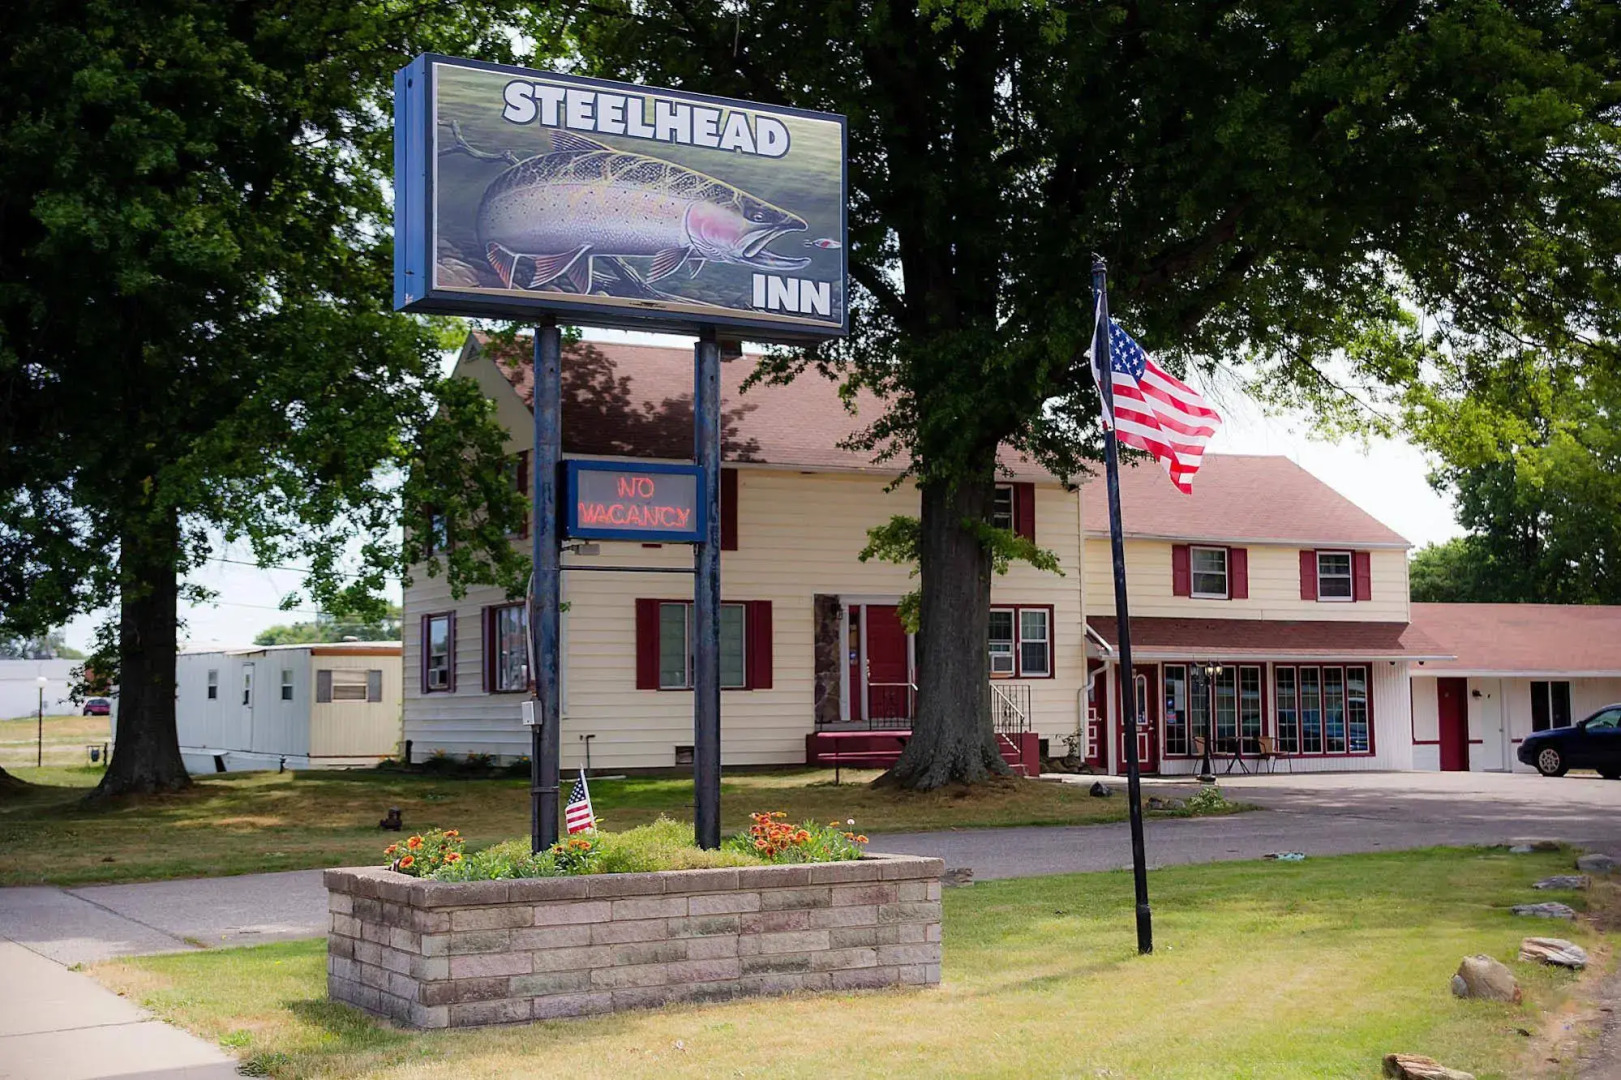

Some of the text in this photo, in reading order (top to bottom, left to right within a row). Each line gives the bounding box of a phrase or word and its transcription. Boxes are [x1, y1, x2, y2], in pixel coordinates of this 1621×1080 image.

[503, 80, 790, 158] STEELHEAD
[752, 273, 832, 317] INN
[617, 476, 655, 498] NO
[578, 502, 691, 528] VACANCY
